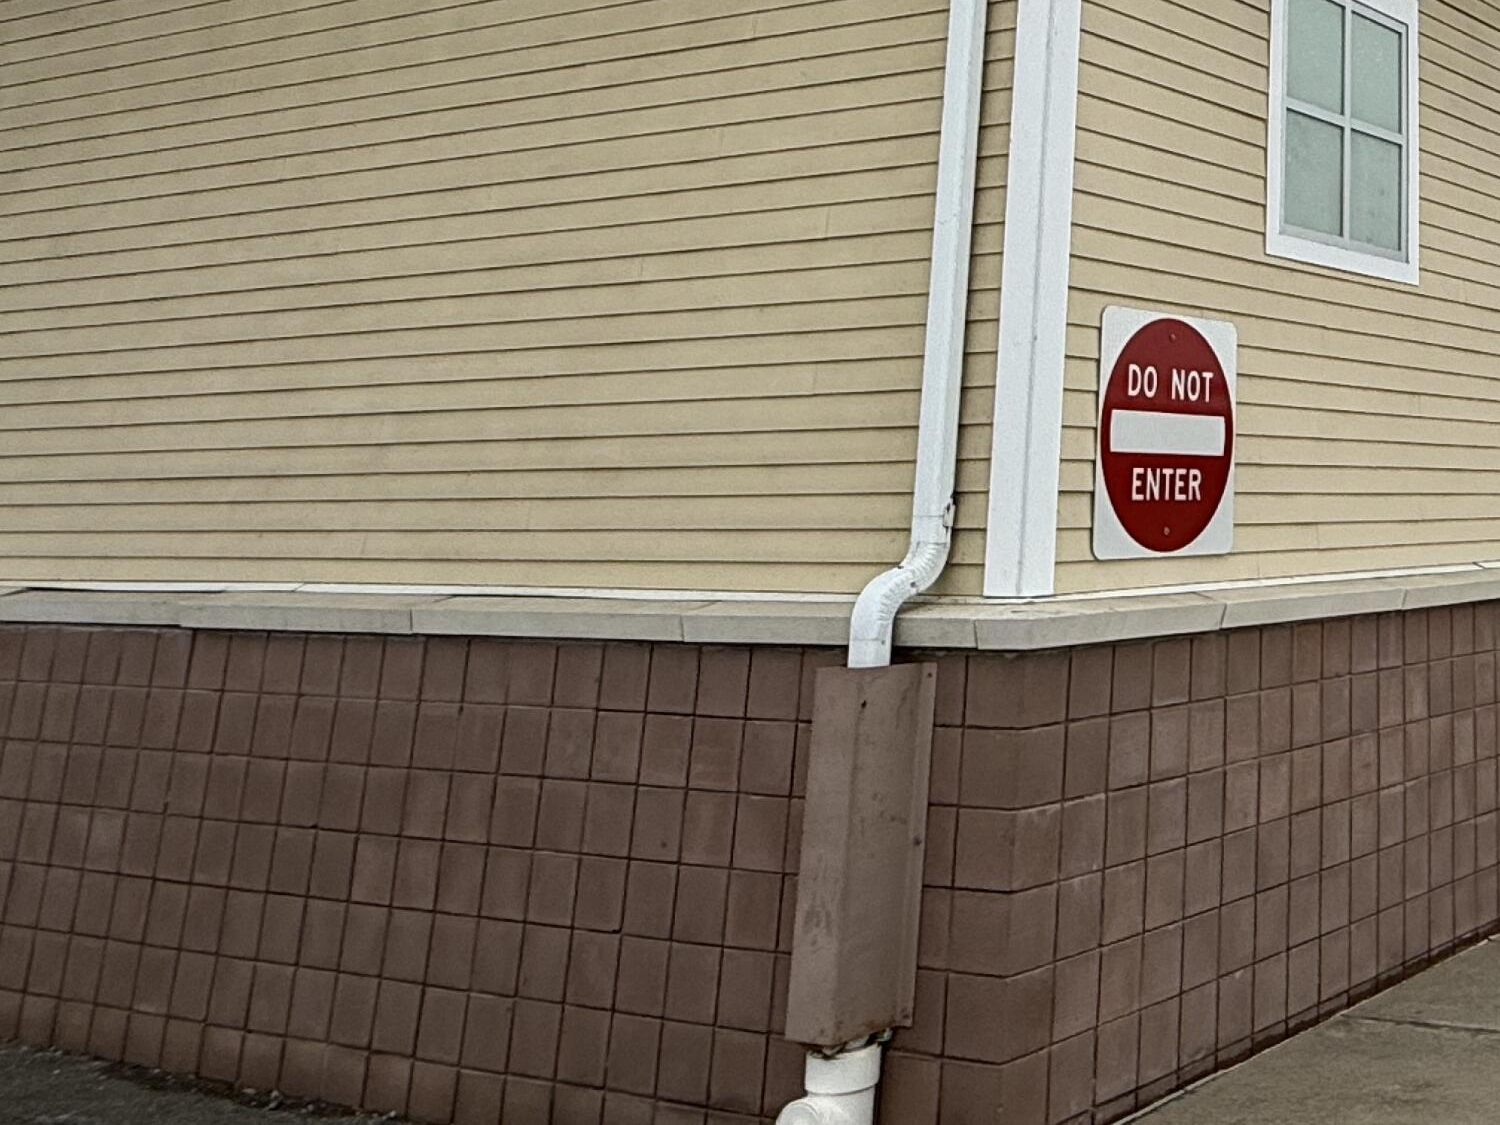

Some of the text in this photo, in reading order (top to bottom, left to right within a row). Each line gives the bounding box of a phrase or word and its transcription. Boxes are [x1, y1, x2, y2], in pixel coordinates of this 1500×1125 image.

[1127, 363, 1213, 403] DO NOT
[1131, 467, 1202, 501] ENTER
